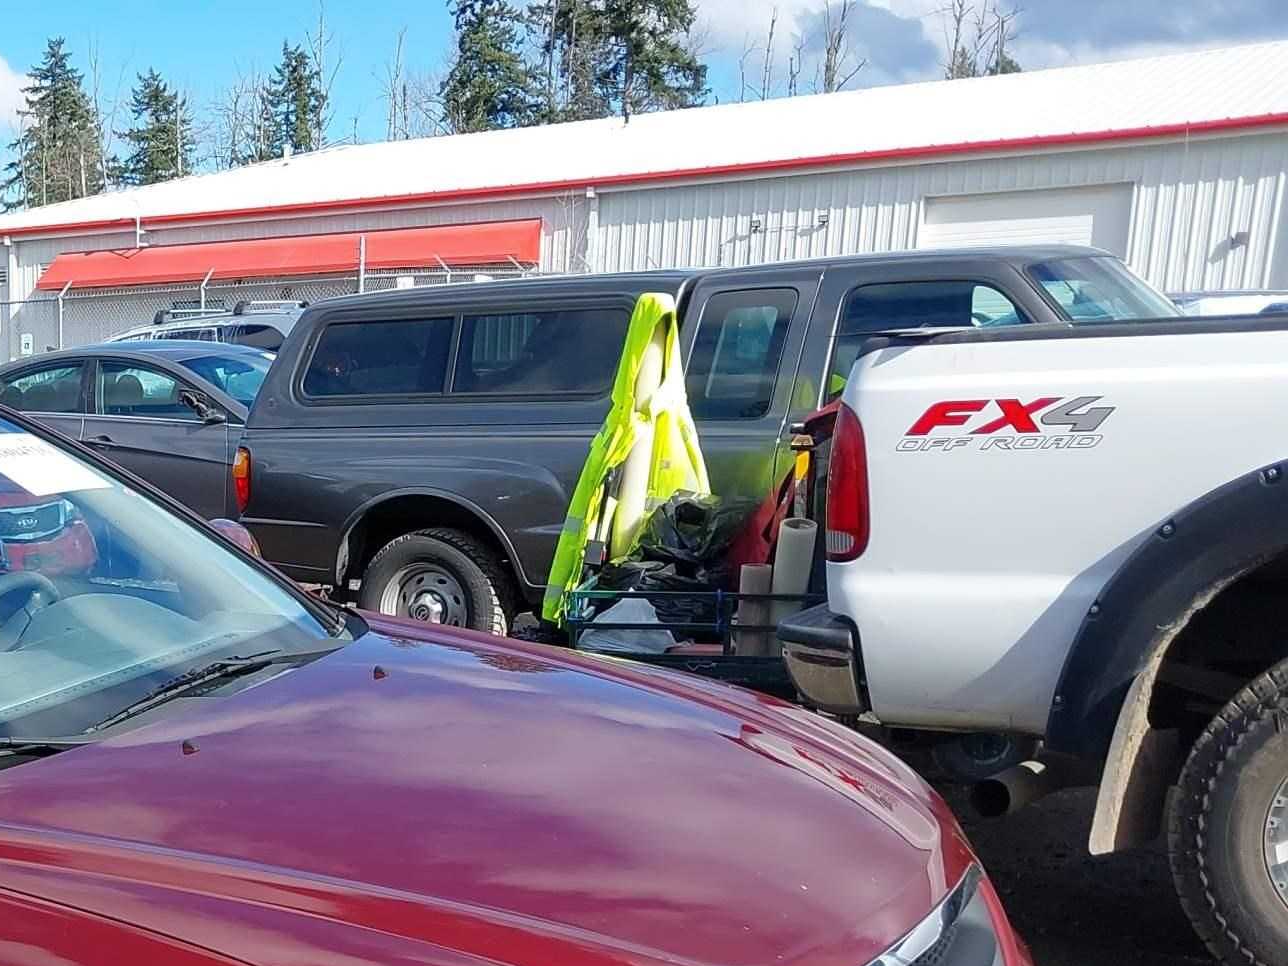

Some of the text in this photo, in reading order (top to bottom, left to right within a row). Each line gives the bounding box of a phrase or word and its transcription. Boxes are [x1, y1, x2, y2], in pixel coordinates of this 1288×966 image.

[905, 396, 1116, 436] FX4
[895, 434, 1103, 452] OFF ROAD
